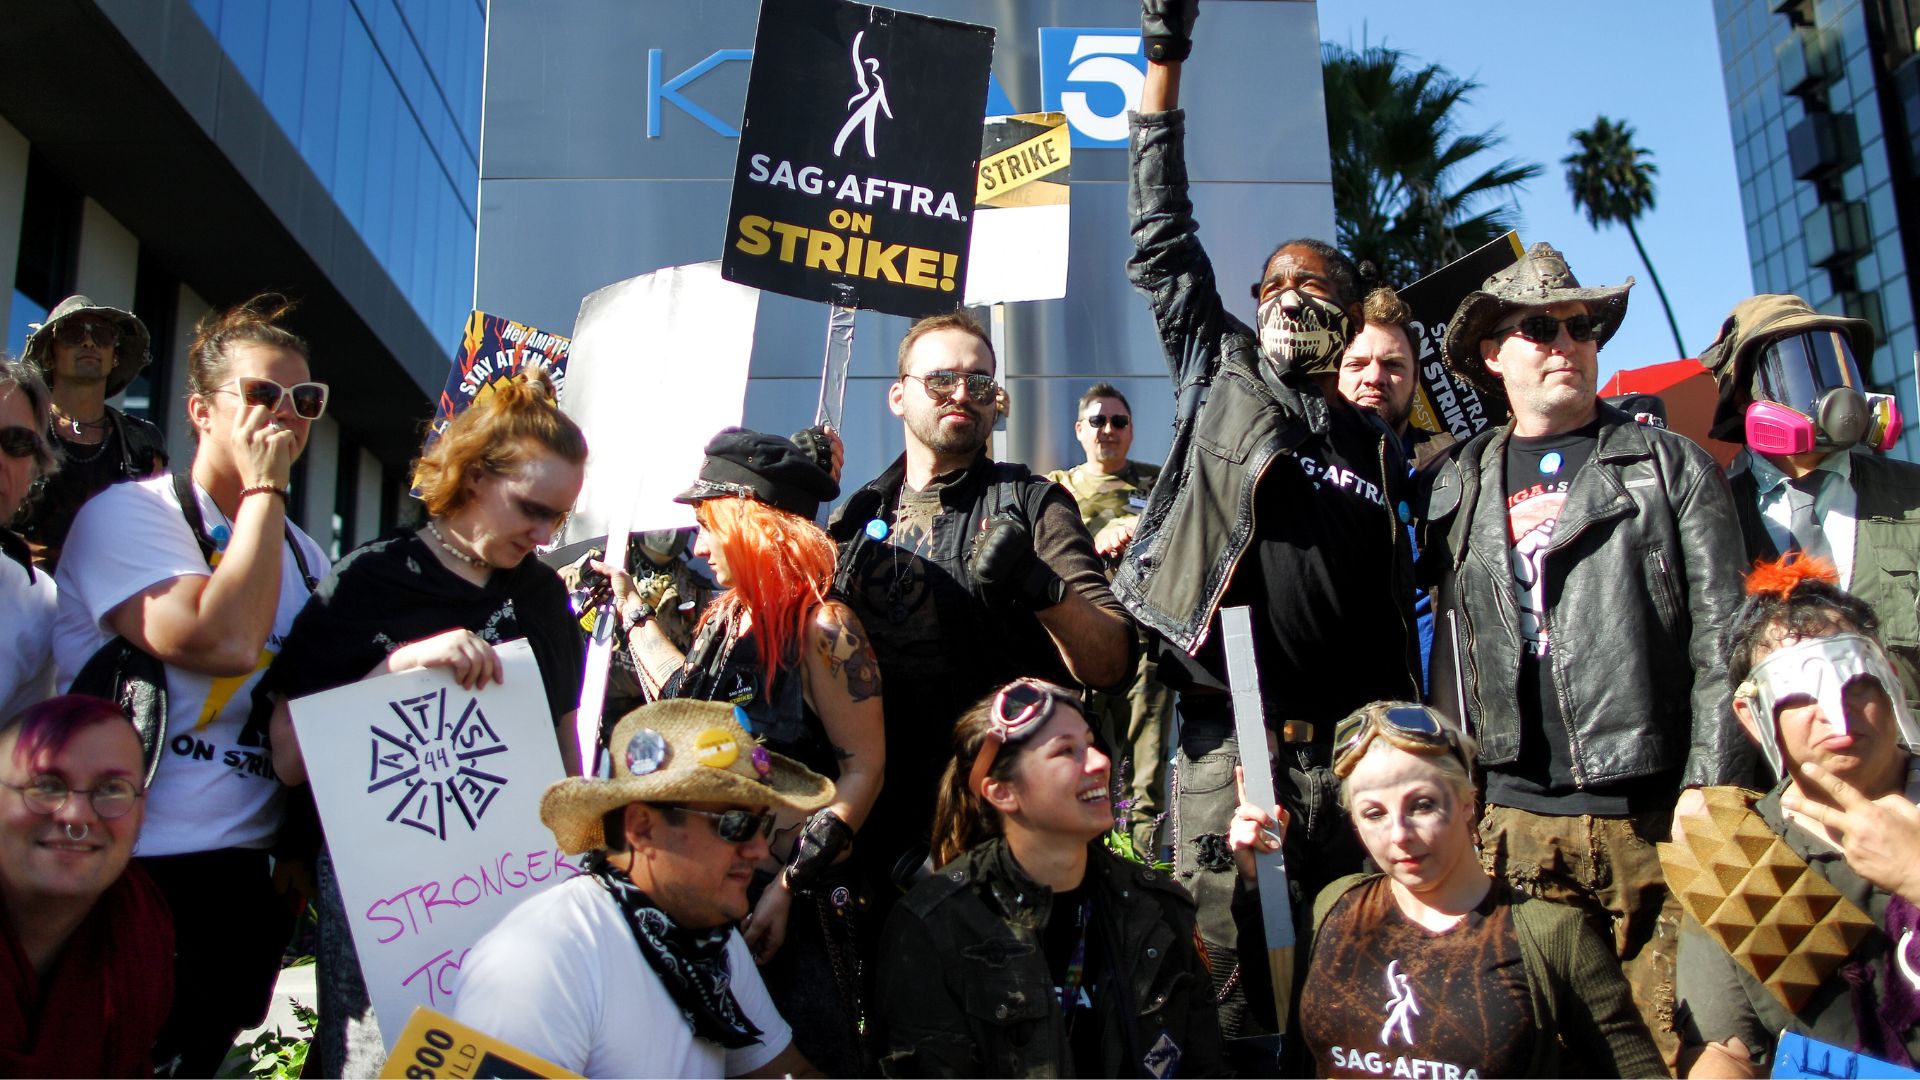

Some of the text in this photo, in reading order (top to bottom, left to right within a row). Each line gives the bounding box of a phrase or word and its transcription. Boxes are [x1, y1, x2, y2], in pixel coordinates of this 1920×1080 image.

[1060, 35, 1146, 141] 5
[980, 138, 1060, 190] STRIKE
[829, 209, 872, 234] ON
[736, 214, 958, 292] STRIKE!
[502, 323, 572, 358] Hey AMPTP!
[459, 356, 494, 396] STAY
[496, 349, 515, 369] AT
[521, 349, 552, 370] THE
[171, 735, 216, 761] ON
[424, 747, 450, 772] 44
[366, 848, 582, 944] STRONGER
